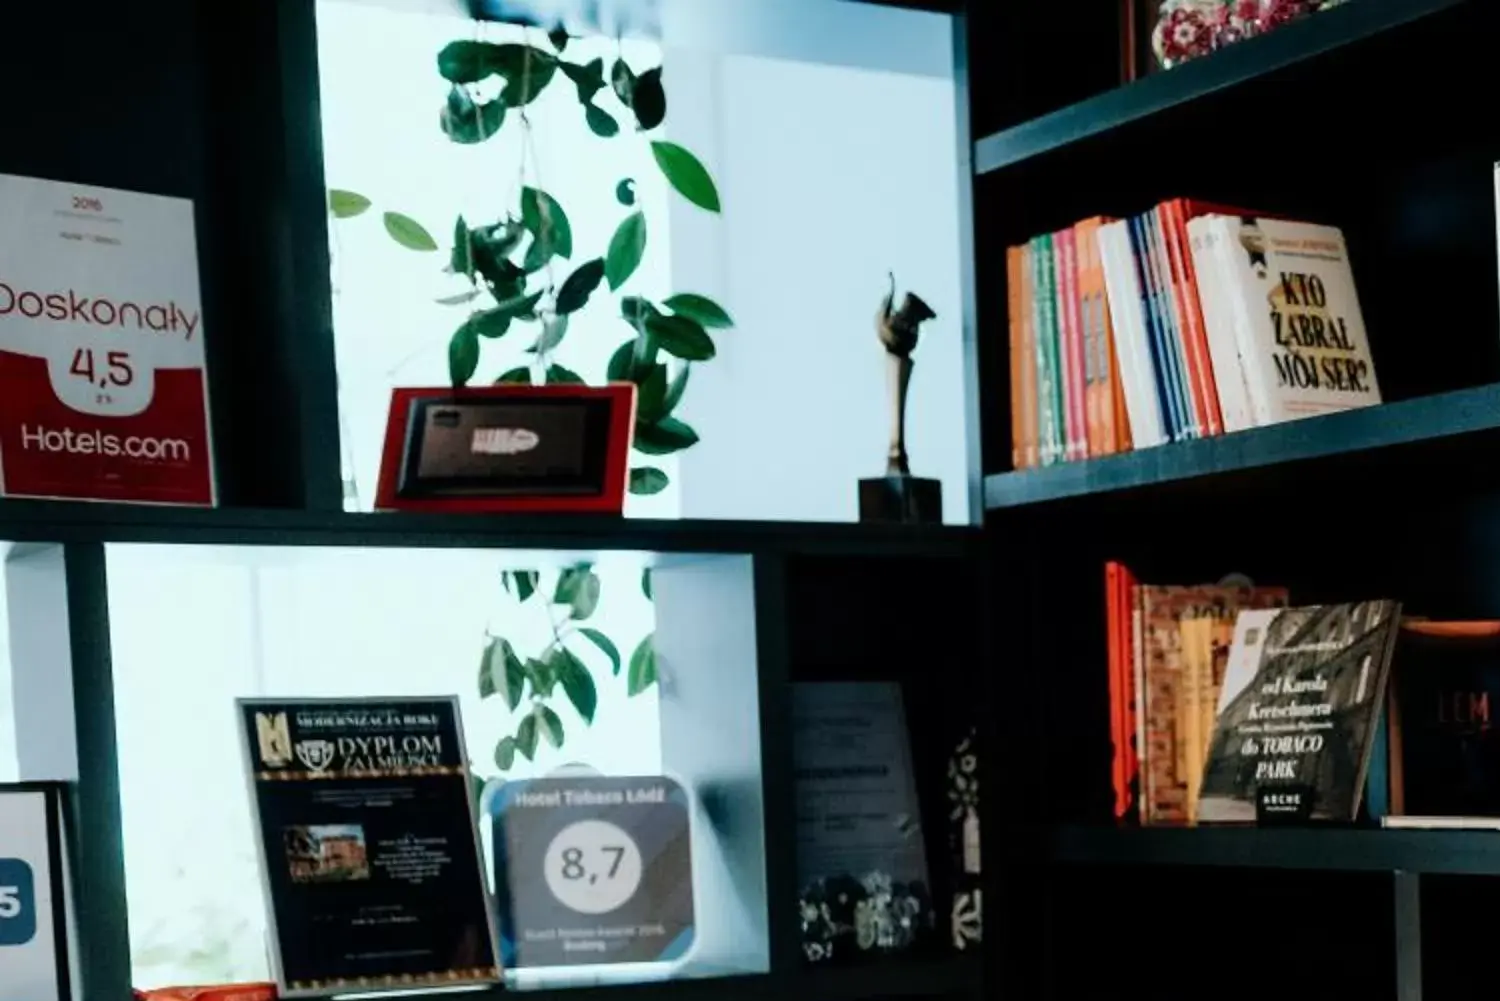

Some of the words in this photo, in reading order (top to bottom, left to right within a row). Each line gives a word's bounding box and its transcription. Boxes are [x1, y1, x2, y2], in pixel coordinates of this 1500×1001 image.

[1280, 271, 1326, 309] KTO
[0, 282, 199, 341] Doskonały
[69, 348, 133, 389] 4,5
[1321, 356, 1370, 393] SER?
[22, 423, 190, 461] Hotels.com
[337, 734, 442, 757] DYPLOM
[1255, 758, 1298, 779] PARK
[561, 846, 626, 886] 8,7
